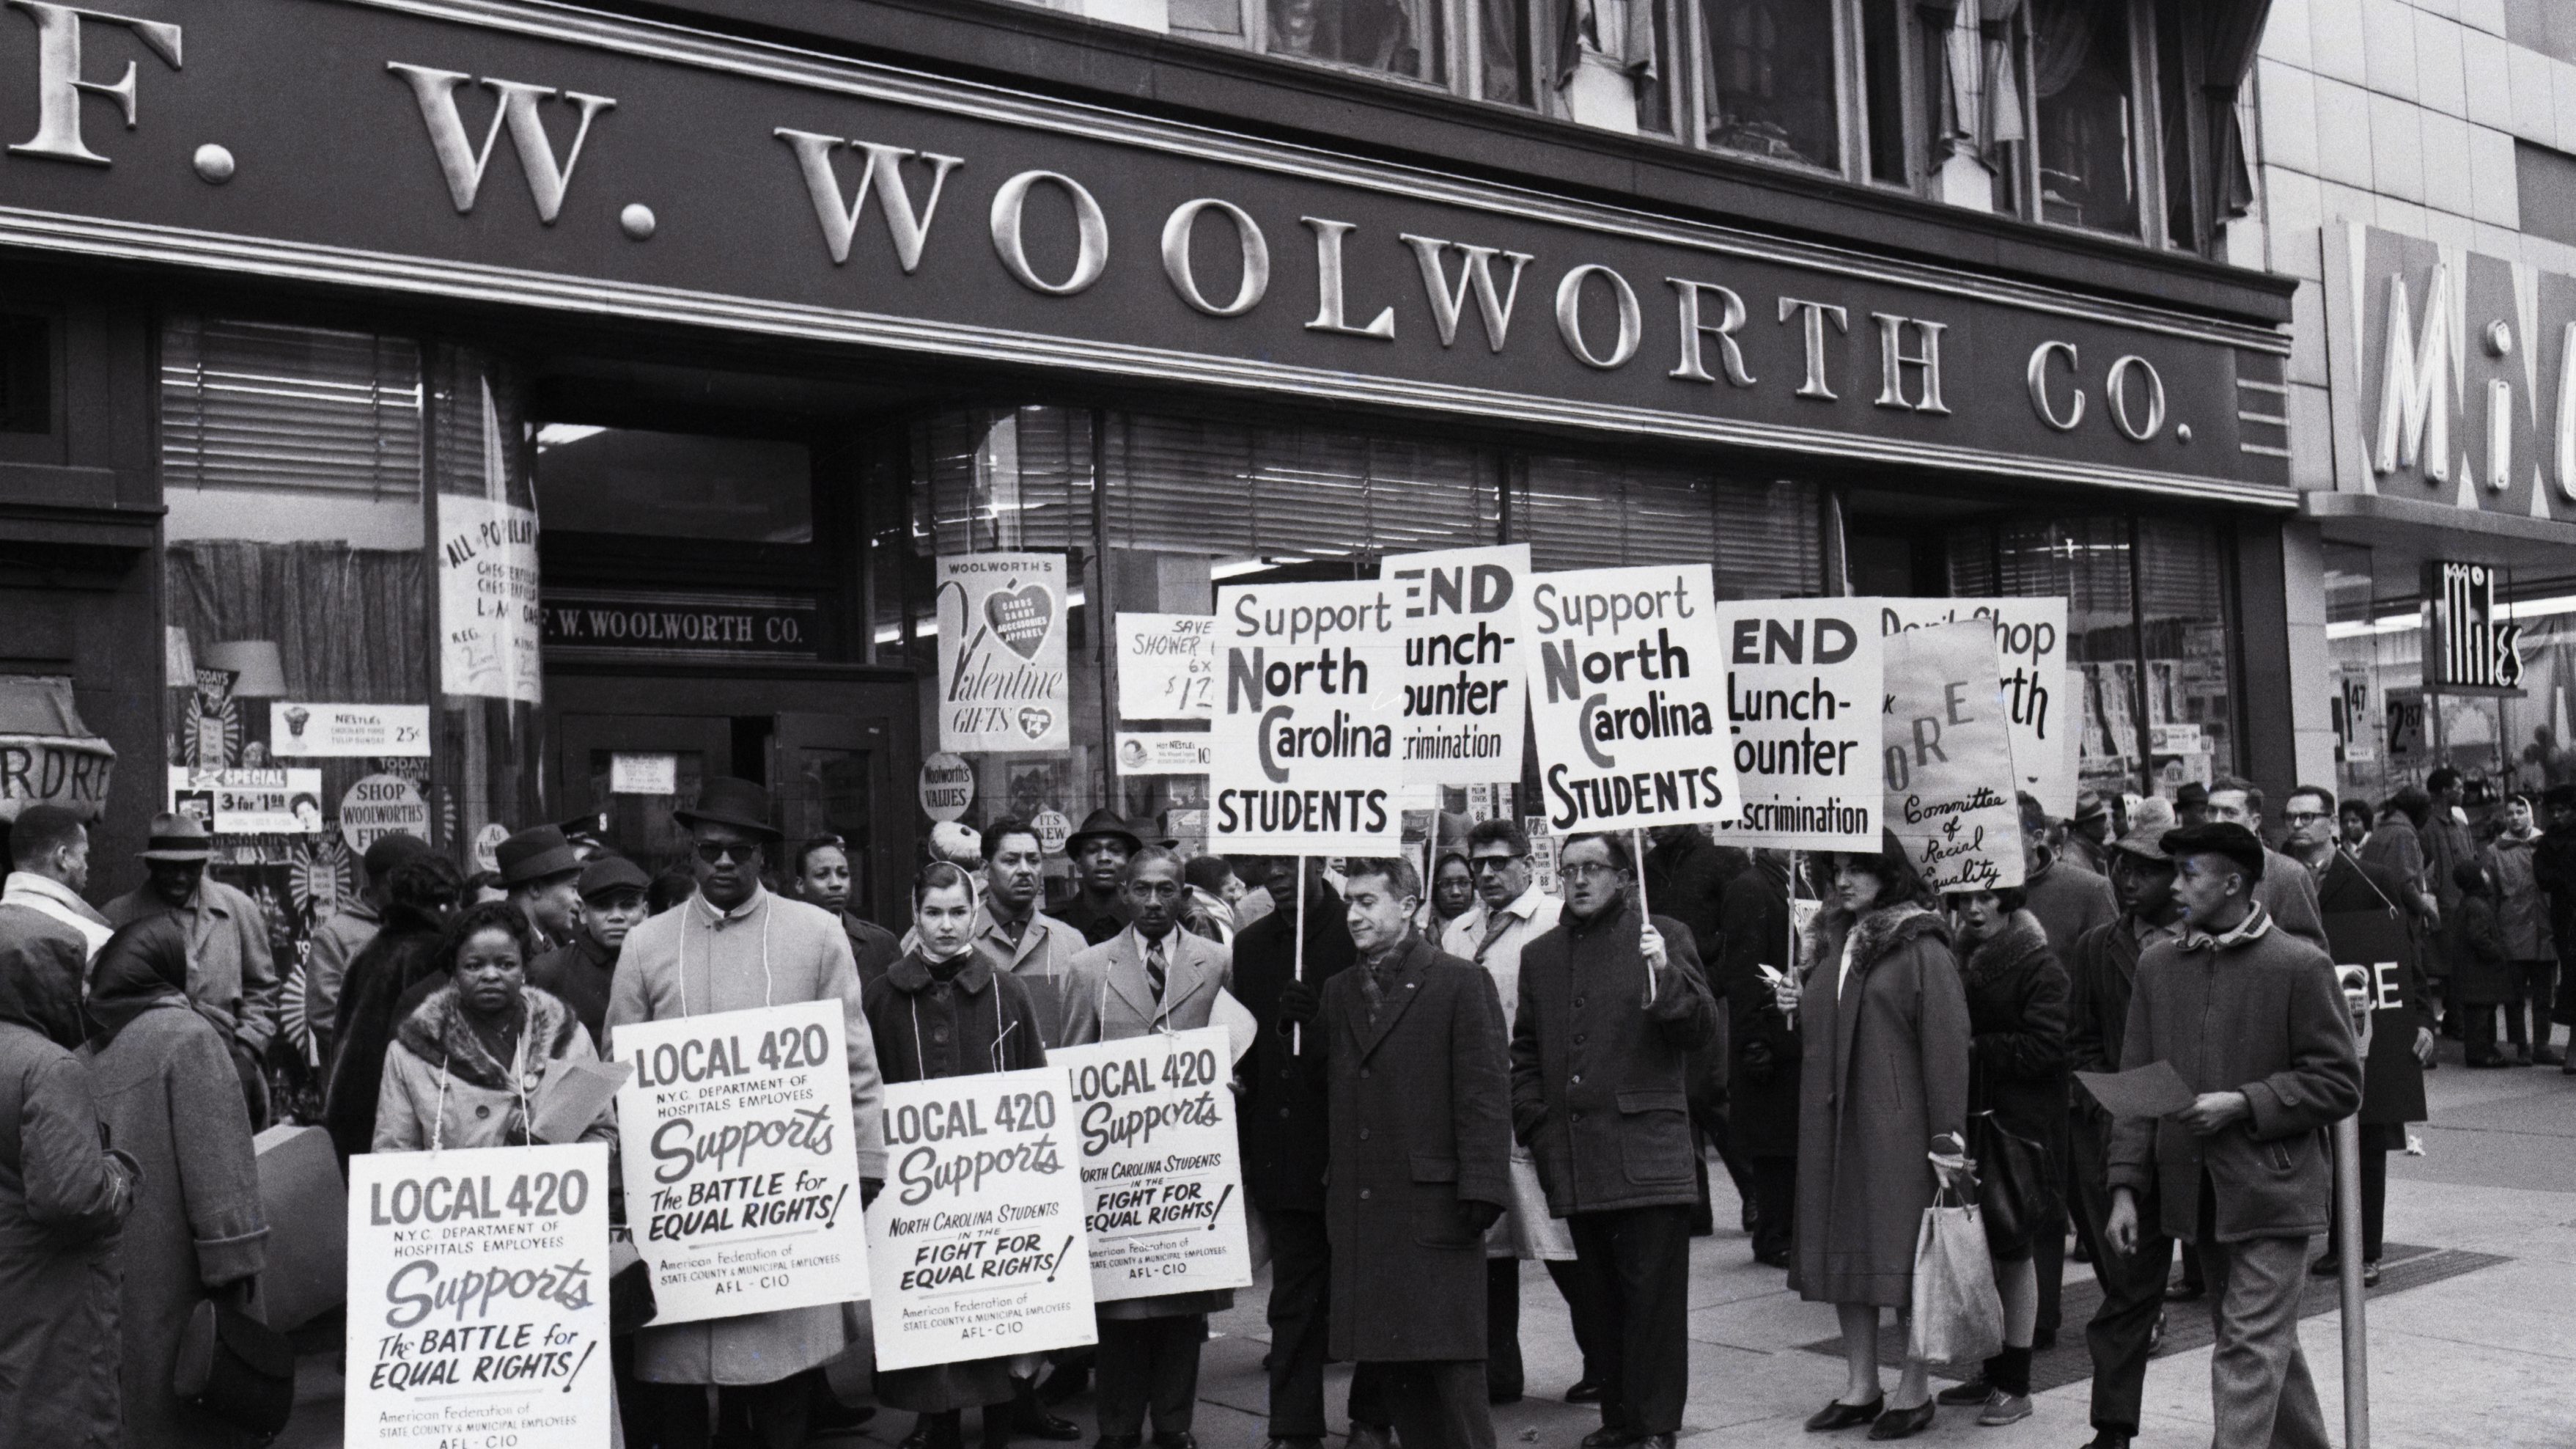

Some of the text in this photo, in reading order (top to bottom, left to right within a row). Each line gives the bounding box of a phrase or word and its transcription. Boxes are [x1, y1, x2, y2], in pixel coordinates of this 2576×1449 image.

[3, 1, 2192, 441] F. W. WOOLWORTH CO.
[446, 534, 476, 569] ALL
[949, 562, 1053, 574] WOOLWORTH'S
[1235, 592, 1391, 645] Support
[1534, 576, 1695, 637] Support
[558, 609, 584, 637] W.
[588, 609, 754, 642] WOOLWORTH
[766, 617, 803, 643] CO.
[937, 578, 1063, 702] Valentine
[998, 616, 1048, 634] ACCESSORIES
[1006, 628, 1044, 642] APPAREL
[1172, 620, 1213, 635] SAVE
[1732, 617, 1858, 665] END
[1133, 634, 1201, 656] SHOWER
[1405, 621, 1515, 667] unch-
[1227, 647, 1368, 714] North
[1541, 628, 1690, 704] North
[1403, 670, 1509, 717] ounter
[1728, 672, 1851, 722] Lunch-
[953, 706, 1013, 733] GIFTS
[1026, 720, 1043, 734] 14
[1579, 690, 1713, 768] Carolina
[1885, 681, 1974, 792] ORE
[1258, 705, 1391, 784] Carolina
[1402, 724, 1501, 760] rimination
[1730, 726, 1858, 776] ounter
[224, 769, 284, 785] SPECIAL
[356, 784, 406, 801] SHOP
[924, 764, 970, 785] Woolworth's
[221, 793, 254, 811] 3 for
[926, 788, 967, 808] VALUES
[1218, 789, 1388, 834] STUDENTS
[1548, 763, 1723, 830] STUDENTS
[1721, 793, 1868, 834] scrimination
[1921, 826, 1984, 865] Racial
[1943, 815, 1963, 840] of
[636, 1023, 829, 1088] LOCAL 420
[699, 1077, 784, 1098] DEPARTMENT
[790, 1074, 808, 1087] OF
[1069, 1049, 1217, 1102] LOCAL 420
[658, 1089, 814, 1118] HOSPITALS EMPLOYEES
[882, 1090, 1056, 1145] LOCAL 420
[1081, 1090, 1223, 1156] Supports
[650, 1104, 834, 1184] Supports
[898, 1132, 1064, 1207] Supports
[1111, 1153, 1221, 1180] CAROLINA STUDENTS
[1146, 1177, 1164, 1186] THE
[370, 1170, 589, 1226] LOCAL 420
[650, 1170, 827, 1211] The BATTLE for
[1085, 1184, 1234, 1233] EQUAL RIGHTS!
[1097, 1182, 1201, 1212] FIGHT FOR
[443, 1223, 534, 1239] DEPARTMENT
[541, 1221, 560, 1232] OF
[649, 1183, 849, 1241] EQUAL RIGHTS!
[888, 1202, 1060, 1238] NORTH CAROLINA STUDENTS
[394, 1236, 564, 1258] HOSPITALS EMPLOYEES
[915, 1233, 1041, 1266] FIGHT FOR
[957, 1228, 1001, 1241] IN THE
[1180, 1237, 1189, 1247] of
[660, 1244, 792, 1272] American Federation of
[691, 1269, 726, 1281] COUNTY
[737, 1261, 788, 1275] MUNICIPAL
[791, 1254, 841, 1268] EMPLOYEES
[900, 1235, 1074, 1291] EQUAL RIGHTS!
[1109, 1257, 1136, 1268] COUNTY
[1144, 1252, 1181, 1263] MUNICIPAL
[1185, 1246, 1226, 1258] EMPLOYEES
[386, 1258, 594, 1329] Supports
[902, 1292, 1028, 1319] American Federation of
[931, 1316, 965, 1328] COUNTY
[975, 1310, 1023, 1323] MUNICIPAL
[1026, 1302, 1072, 1316] EMPLOYEES
[378, 1323, 578, 1361] The BATTLE for
[369, 1341, 597, 1393] EQUAL RIGHTS!
[379, 1402, 530, 1423] American Federation of
[413, 1425, 452, 1436] COUNTY
[466, 1421, 518, 1431] MUNICIPAL
[522, 1416, 577, 1428] EMPLOYEES
